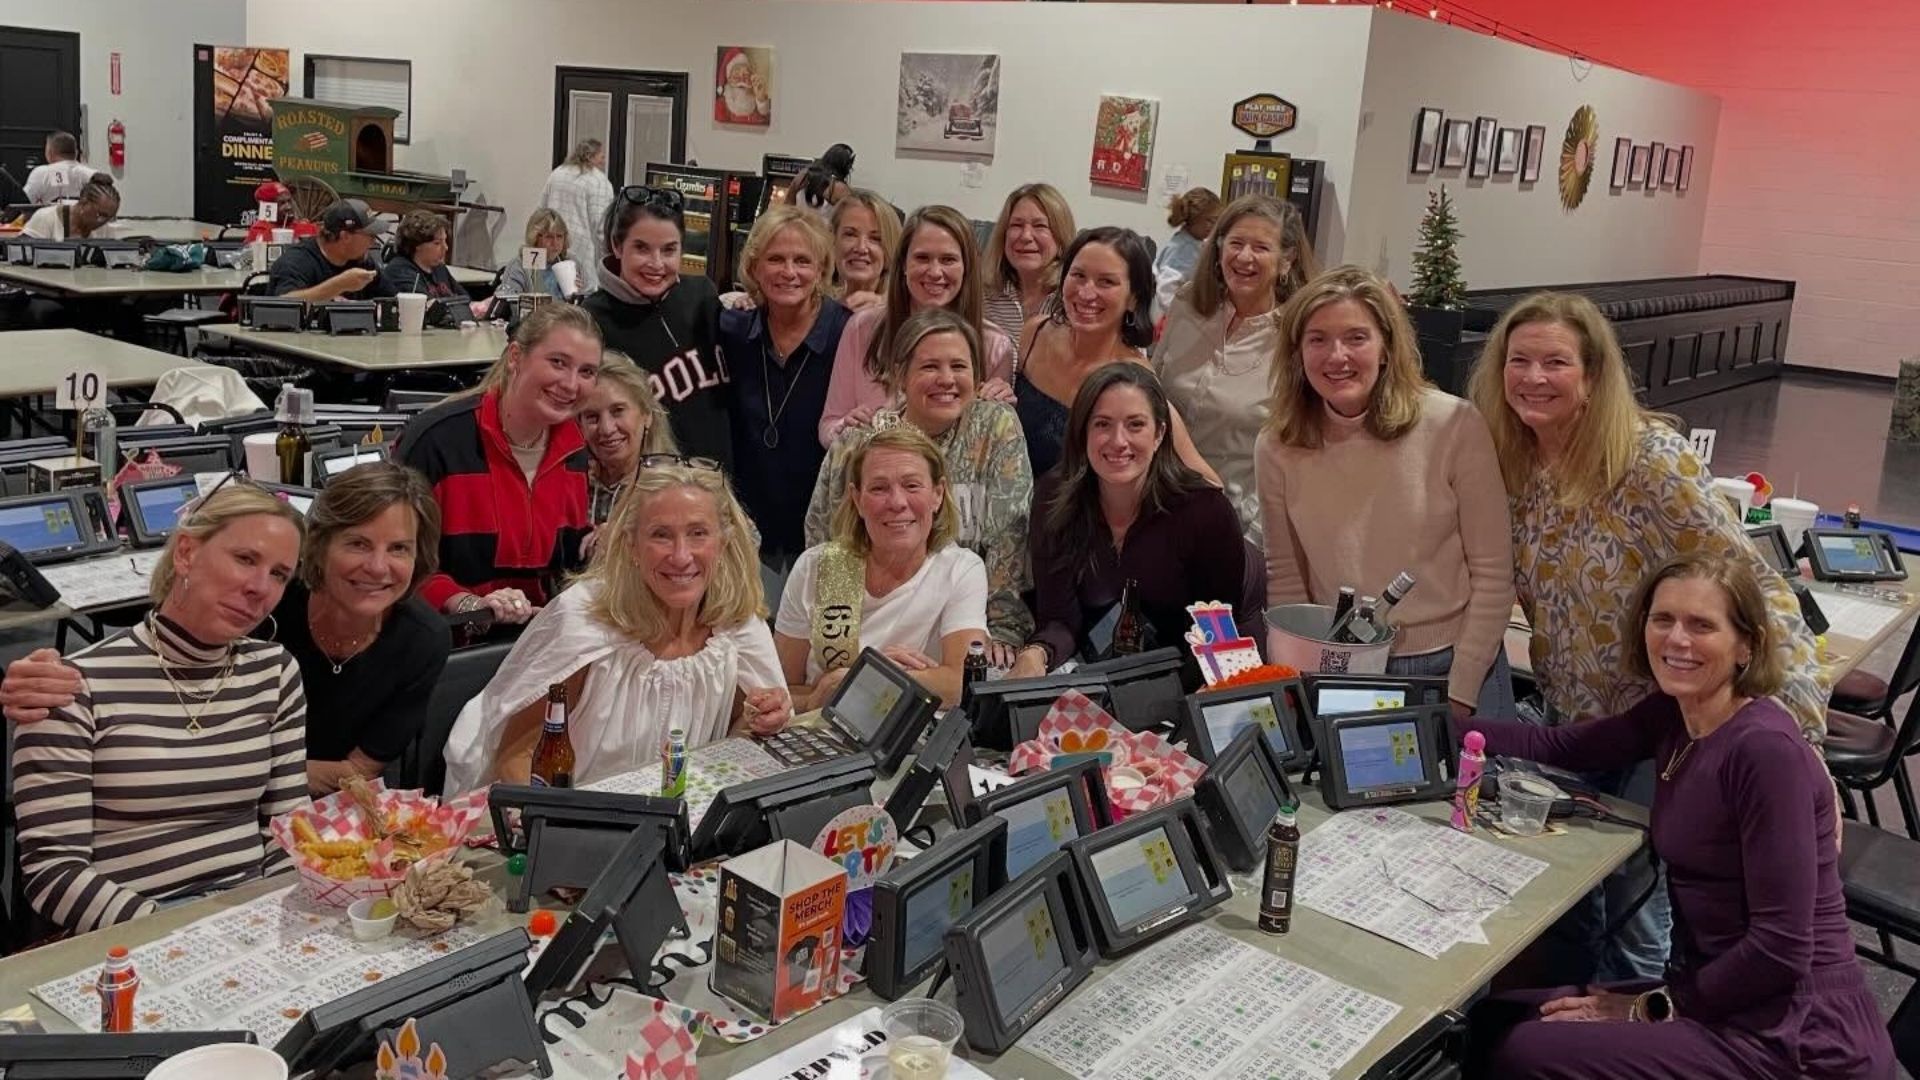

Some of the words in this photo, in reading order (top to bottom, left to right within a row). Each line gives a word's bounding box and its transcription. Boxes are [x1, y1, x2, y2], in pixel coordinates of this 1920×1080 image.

[277, 110, 345, 136] ROASTED
[223, 135, 273, 145] COMPLIMENTA
[222, 143, 273, 160] DINNE
[280, 156, 339, 174] PEANUTS
[55, 171, 63, 184] 3
[265, 204, 272, 218] 5
[530, 251, 539, 266] 7
[66, 372, 98, 401] 10
[1694, 434, 1710, 458] 11
[788, 892, 819, 914] SHOP
[822, 881, 842, 898] THE
